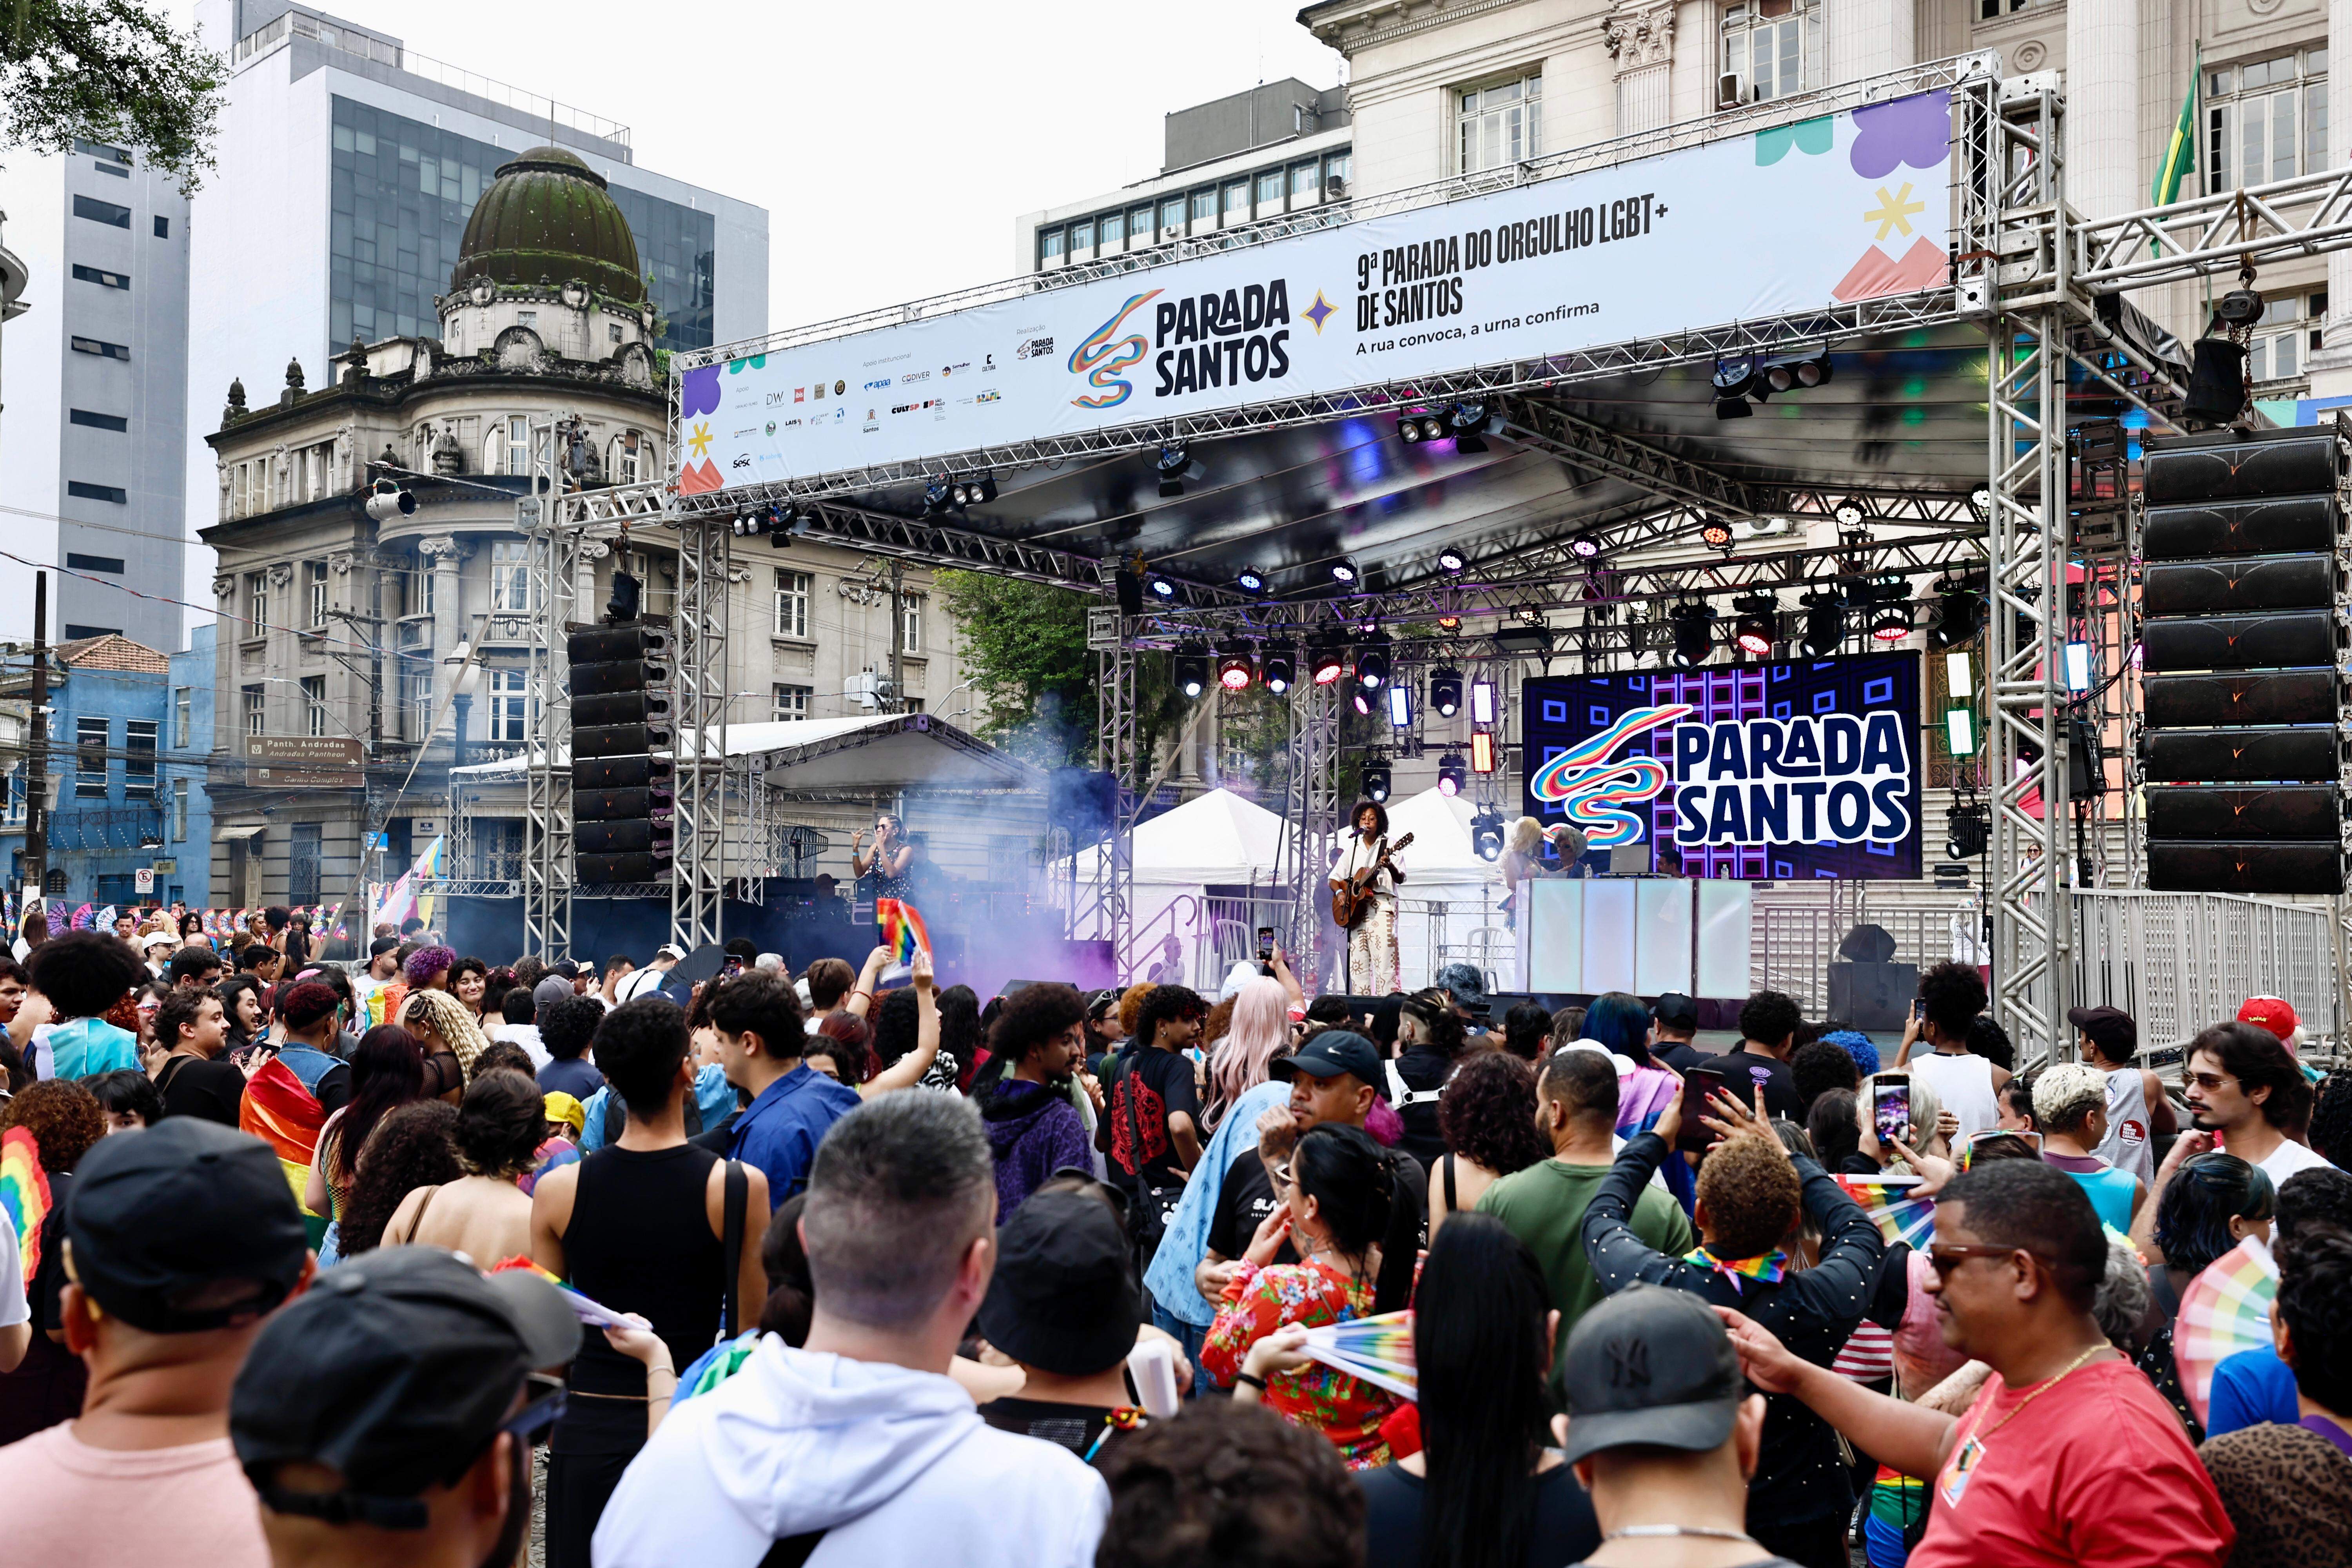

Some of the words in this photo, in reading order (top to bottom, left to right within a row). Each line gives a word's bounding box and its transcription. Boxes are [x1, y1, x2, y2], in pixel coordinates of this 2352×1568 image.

[1383, 236, 1459, 287] PARADA
[1465, 229, 1492, 270] DO
[1497, 207, 1593, 263] ORGULHO
[1599, 193, 1668, 243] LGBT+
[1016, 324, 1045, 335] Realização
[1156, 279, 1290, 348] PARADA
[1356, 343, 1367, 355] A
[1371, 340, 1394, 353] rua
[1399, 328, 1466, 347] convoca,
[1471, 325, 1479, 335] a
[1485, 318, 1520, 332] urna
[1526, 303, 1599, 325] confirma
[1357, 292, 1379, 332] DE
[1384, 277, 1463, 327] SANTOS
[1031, 337, 1053, 349] PARADA
[1031, 345, 1053, 358] SANTOS
[1156, 330, 1289, 397] SANTOS
[873, 379, 891, 389] apaa
[1677, 715, 1905, 782] PARADA
[1677, 779, 1906, 842] SANTOS
